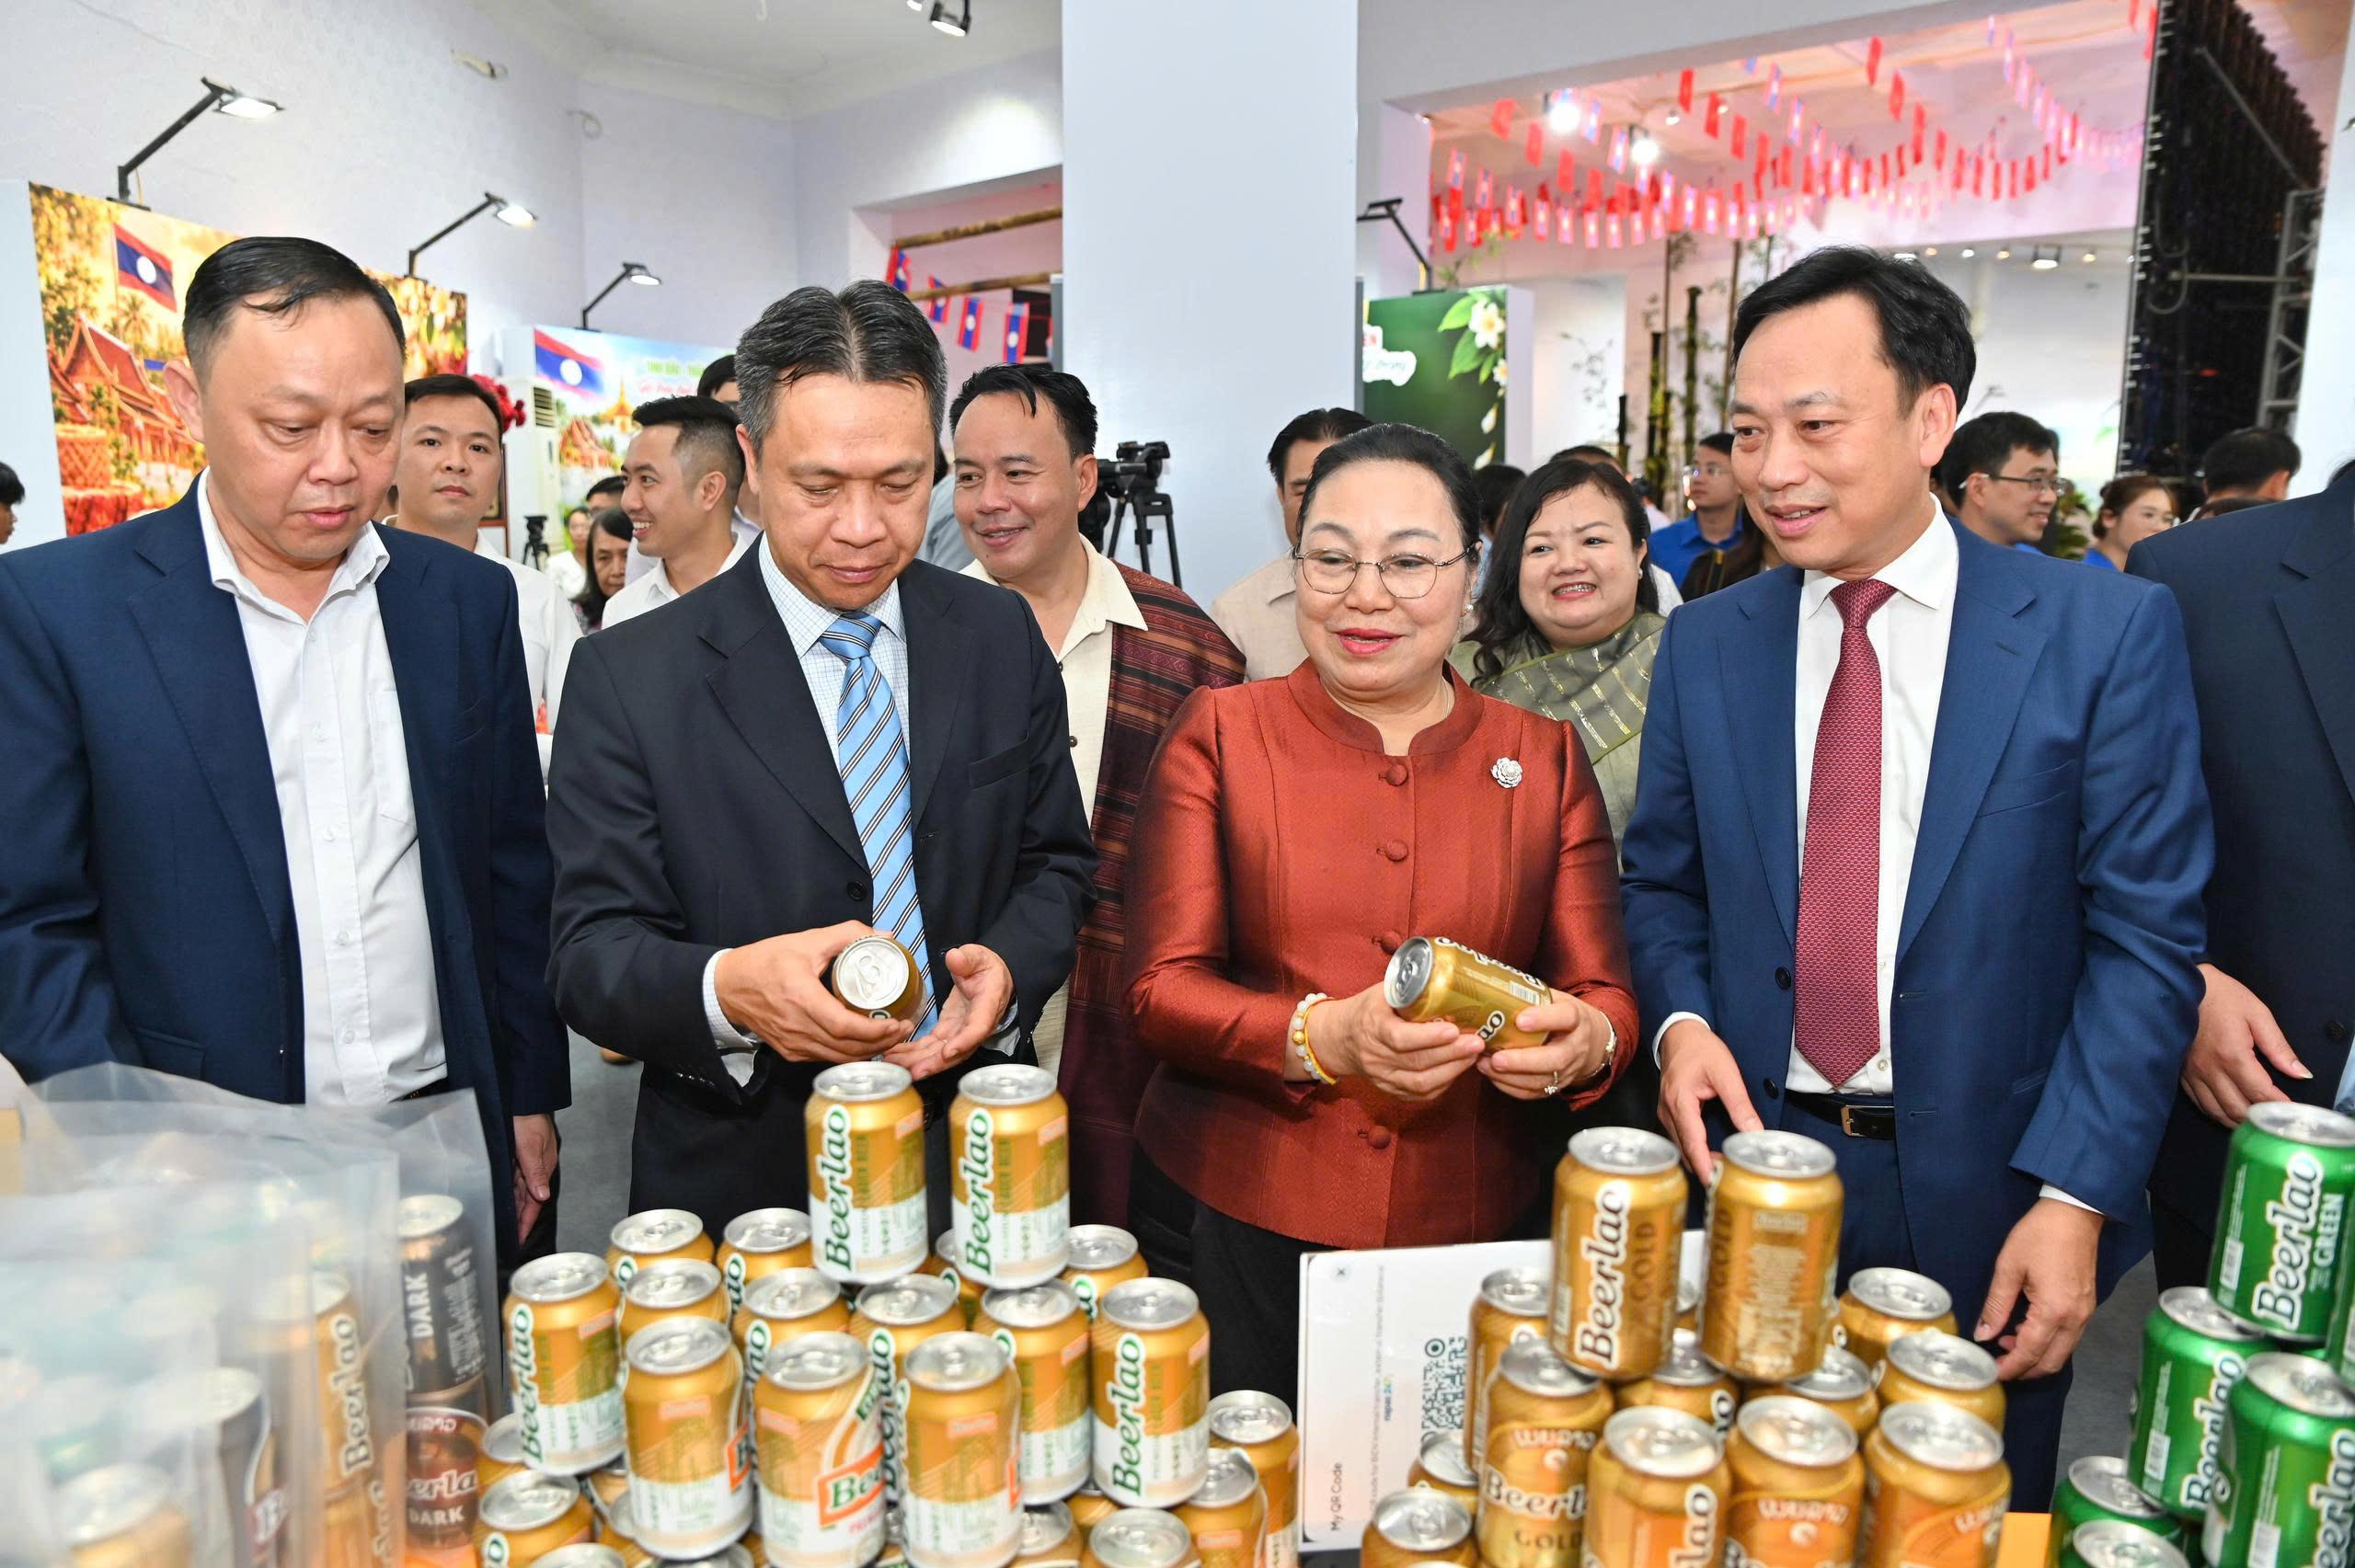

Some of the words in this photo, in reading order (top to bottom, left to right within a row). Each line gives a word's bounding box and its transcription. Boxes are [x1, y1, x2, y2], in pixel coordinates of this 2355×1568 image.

[819, 1105, 853, 1273] Beerlao
[960, 1110, 993, 1276] Beerlao
[1629, 1221, 1655, 1302] GOLD
[2252, 1152, 2324, 1331] Beerlao
[2313, 1194, 2344, 1267] GREEN
[404, 1272, 434, 1339] DARK
[329, 1314, 373, 1474] Beerlao
[511, 1304, 544, 1463] Beerlao
[1109, 1335, 1143, 1496] Beerlao
[409, 1505, 465, 1526] DARK
[1330, 1494, 1341, 1513] QR
[1331, 1462, 1342, 1494] Code
[1486, 1464, 1586, 1520] Beerl
[2308, 1427, 2355, 1568] eerlao
[1330, 1515, 1344, 1531] My
